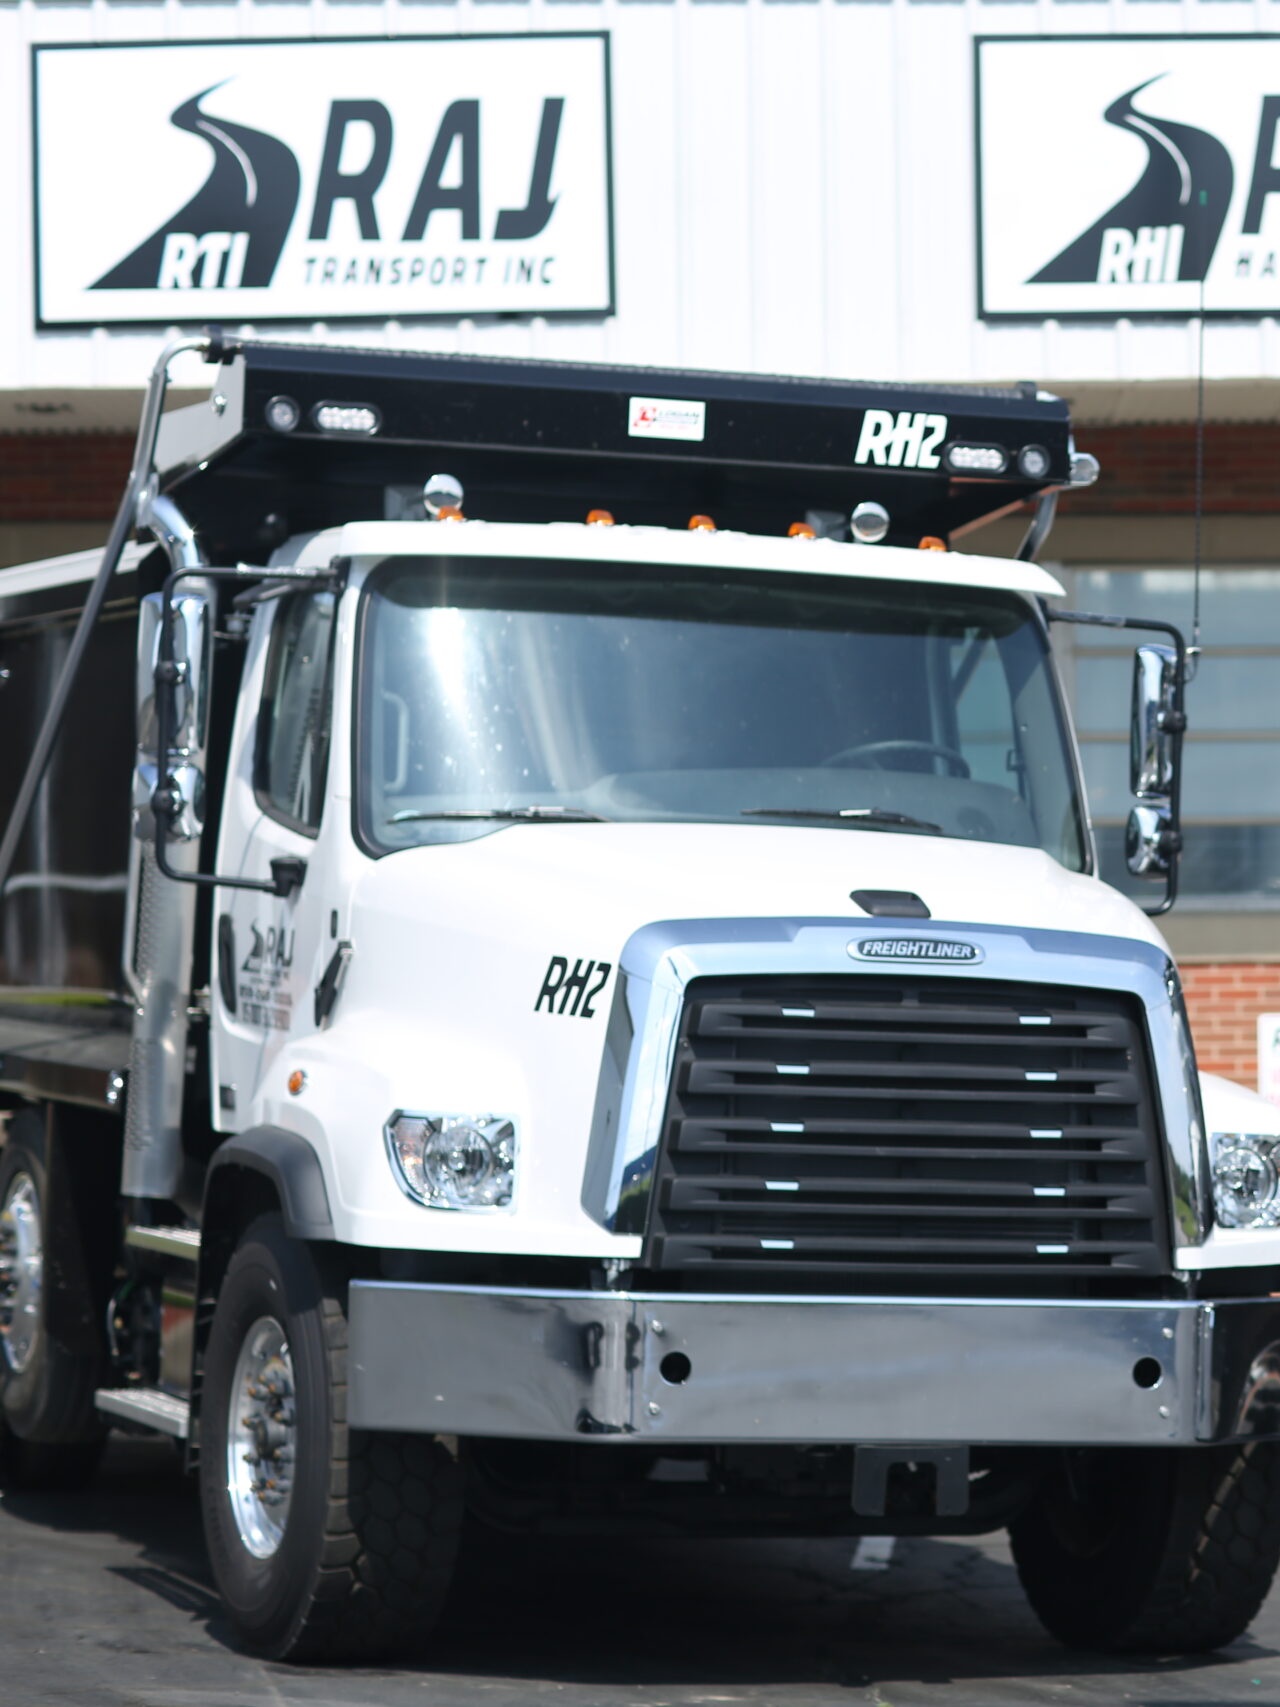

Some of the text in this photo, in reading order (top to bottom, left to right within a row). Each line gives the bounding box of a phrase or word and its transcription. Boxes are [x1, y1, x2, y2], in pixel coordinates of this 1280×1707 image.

[308, 97, 565, 241] RAJ
[157, 231, 250, 288] RTI
[305, 256, 556, 285] TRANSPORT INC
[1097, 224, 1184, 282] RHI
[854, 409, 948, 469] RH2
[861, 940, 972, 959] FREIGHTLINER
[534, 955, 612, 1020] RH2
